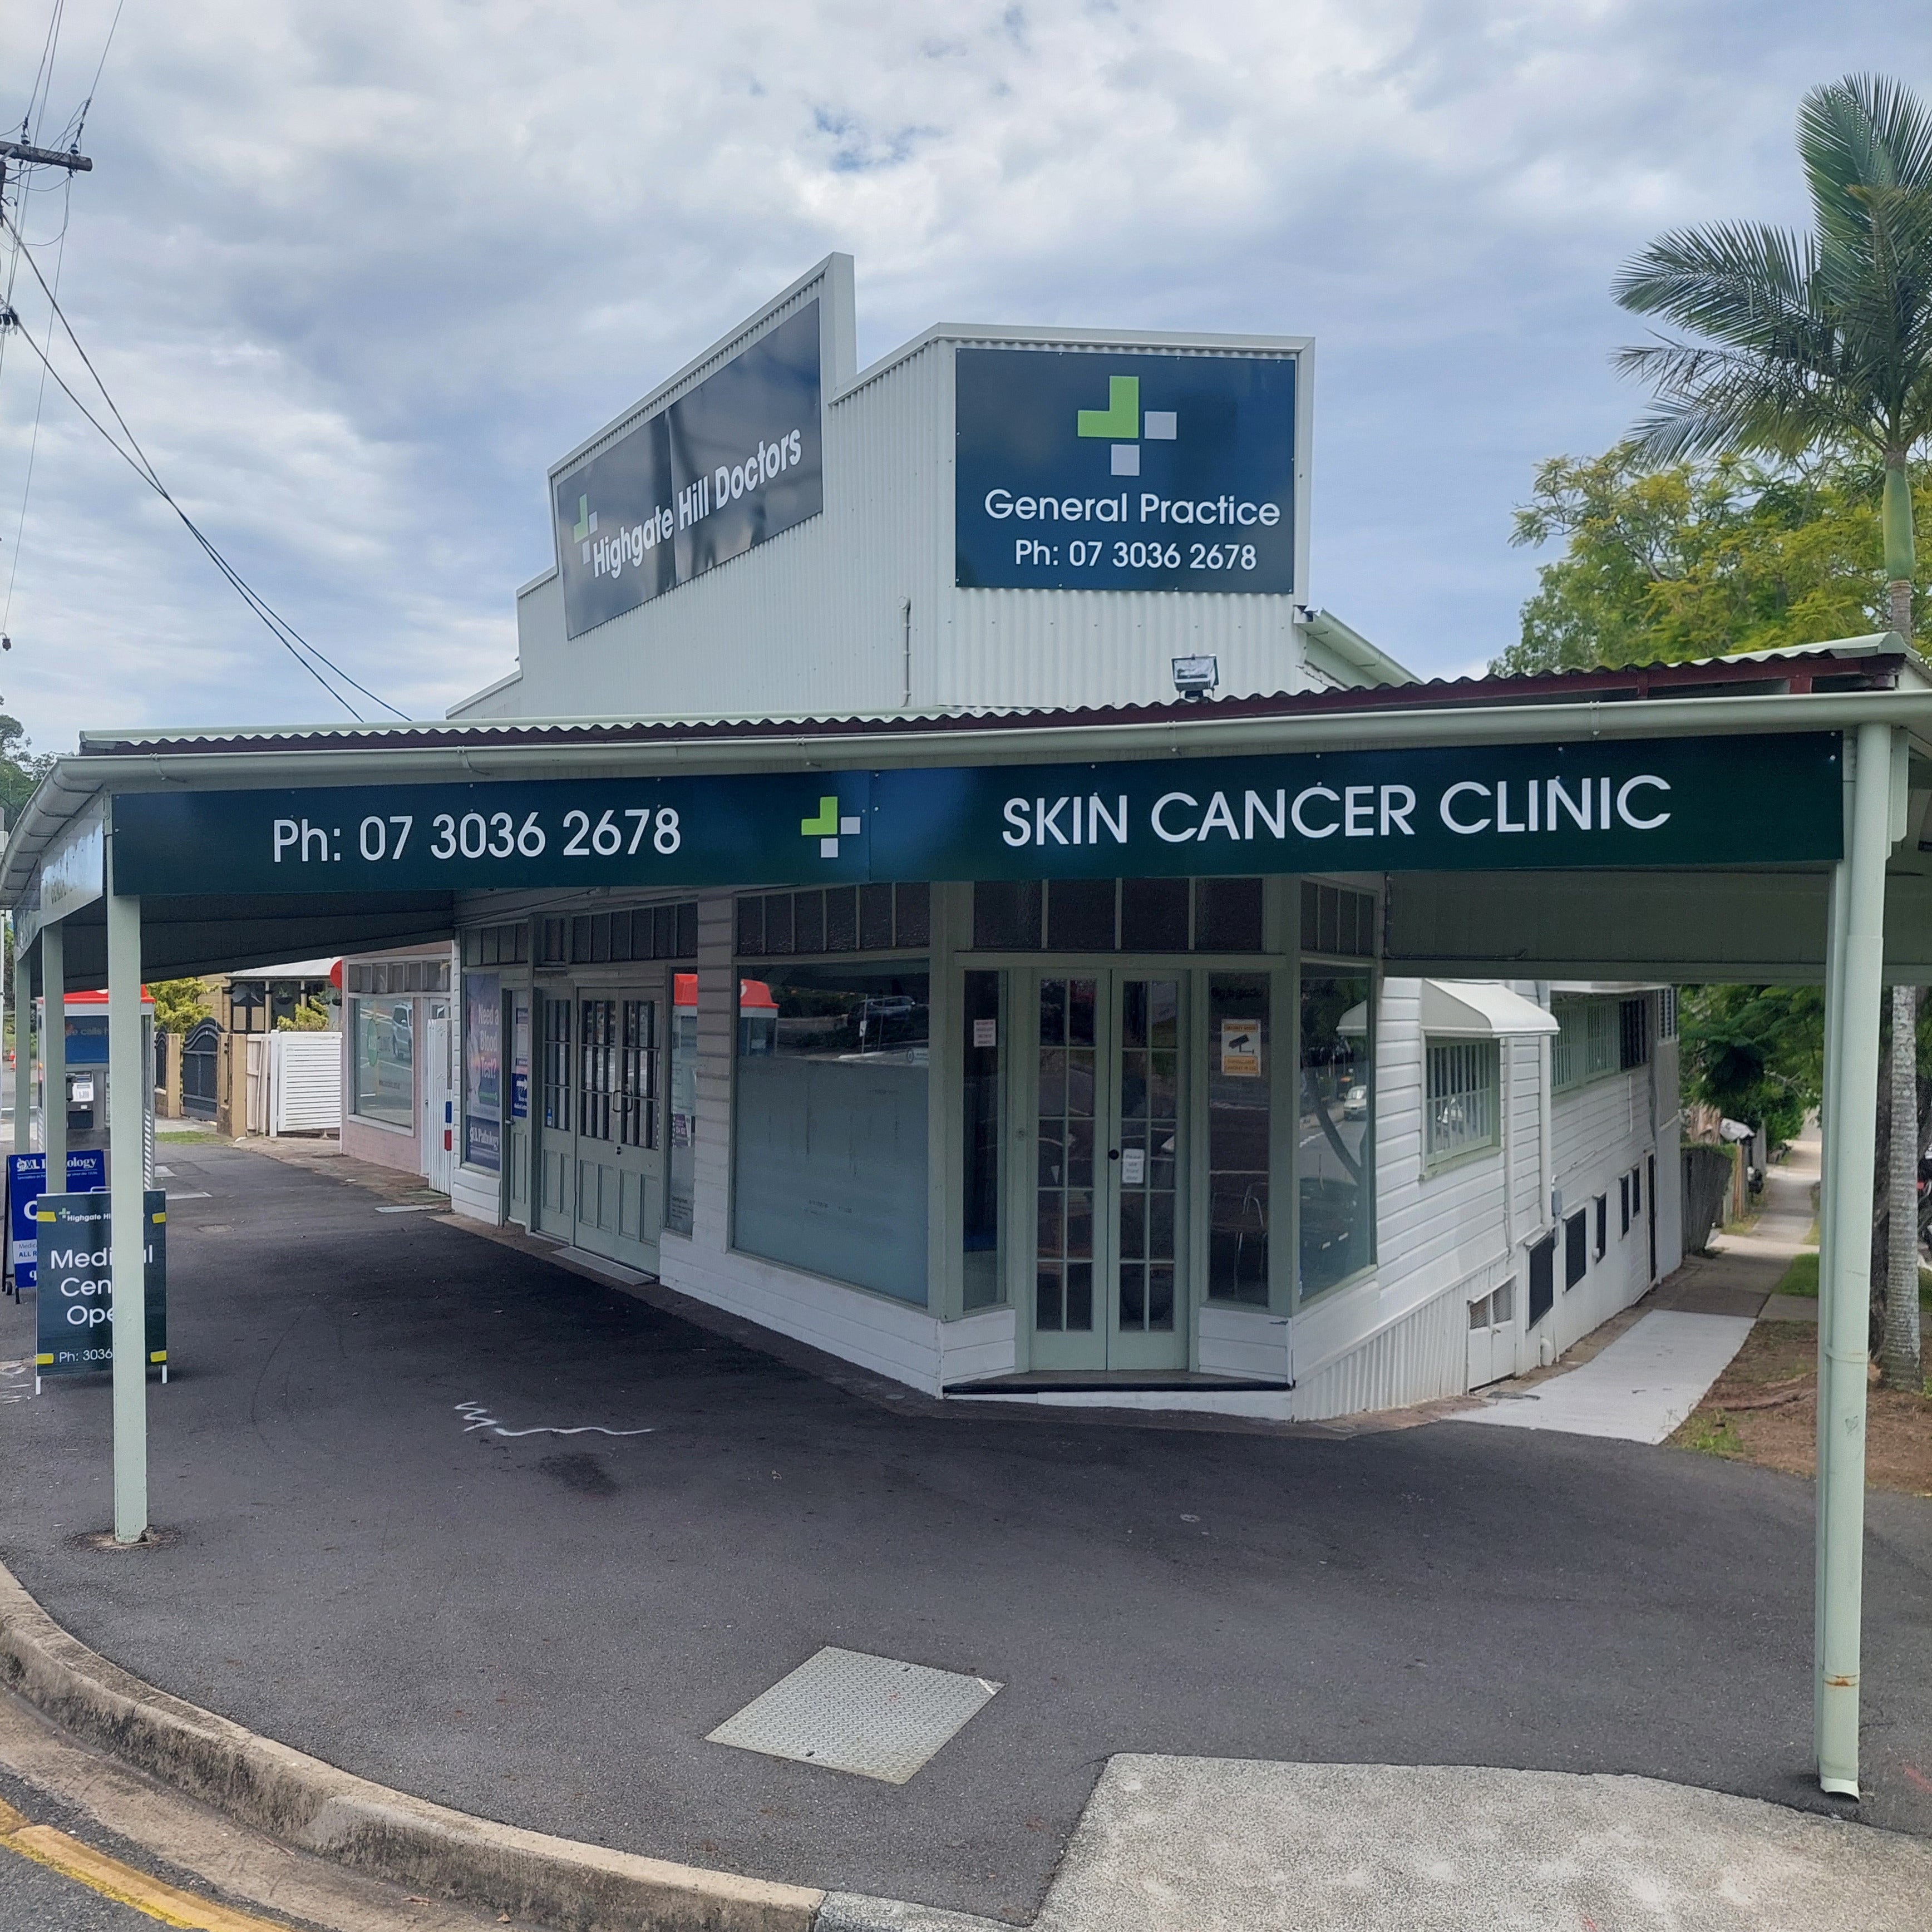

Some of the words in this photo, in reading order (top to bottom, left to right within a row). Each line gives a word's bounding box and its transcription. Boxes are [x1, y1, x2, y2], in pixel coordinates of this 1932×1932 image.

[593, 505, 674, 579] Highgate
[678, 475, 709, 531] Hill
[715, 429, 801, 510] Doctors
[984, 489, 1127, 522] General
[1140, 493, 1280, 526] Practice
[1016, 539, 1058, 565] Ph:
[1069, 541, 1102, 566] 07
[1113, 541, 1181, 568] 3036
[1190, 543, 1256, 570] 2678
[1002, 795, 1127, 847] SKIN
[1151, 785, 1416, 843] CANCER
[1440, 775, 1671, 834] CLINIC
[273, 819, 341, 862] Ph:
[360, 815, 412, 861] 07
[430, 812, 546, 859] 3036
[563, 807, 681, 855] 2678
[478, 1004, 494, 1025] Need
[495, 1008, 499, 1025] a
[480, 1030, 497, 1052] Blood
[481, 1056, 497, 1079] Test?
[67, 1214, 101, 1223] Highgate
[61, 1276, 112, 1297] Cen
[59, 1352, 78, 1363] Ph:
[83, 1348, 113, 1361] 3036
